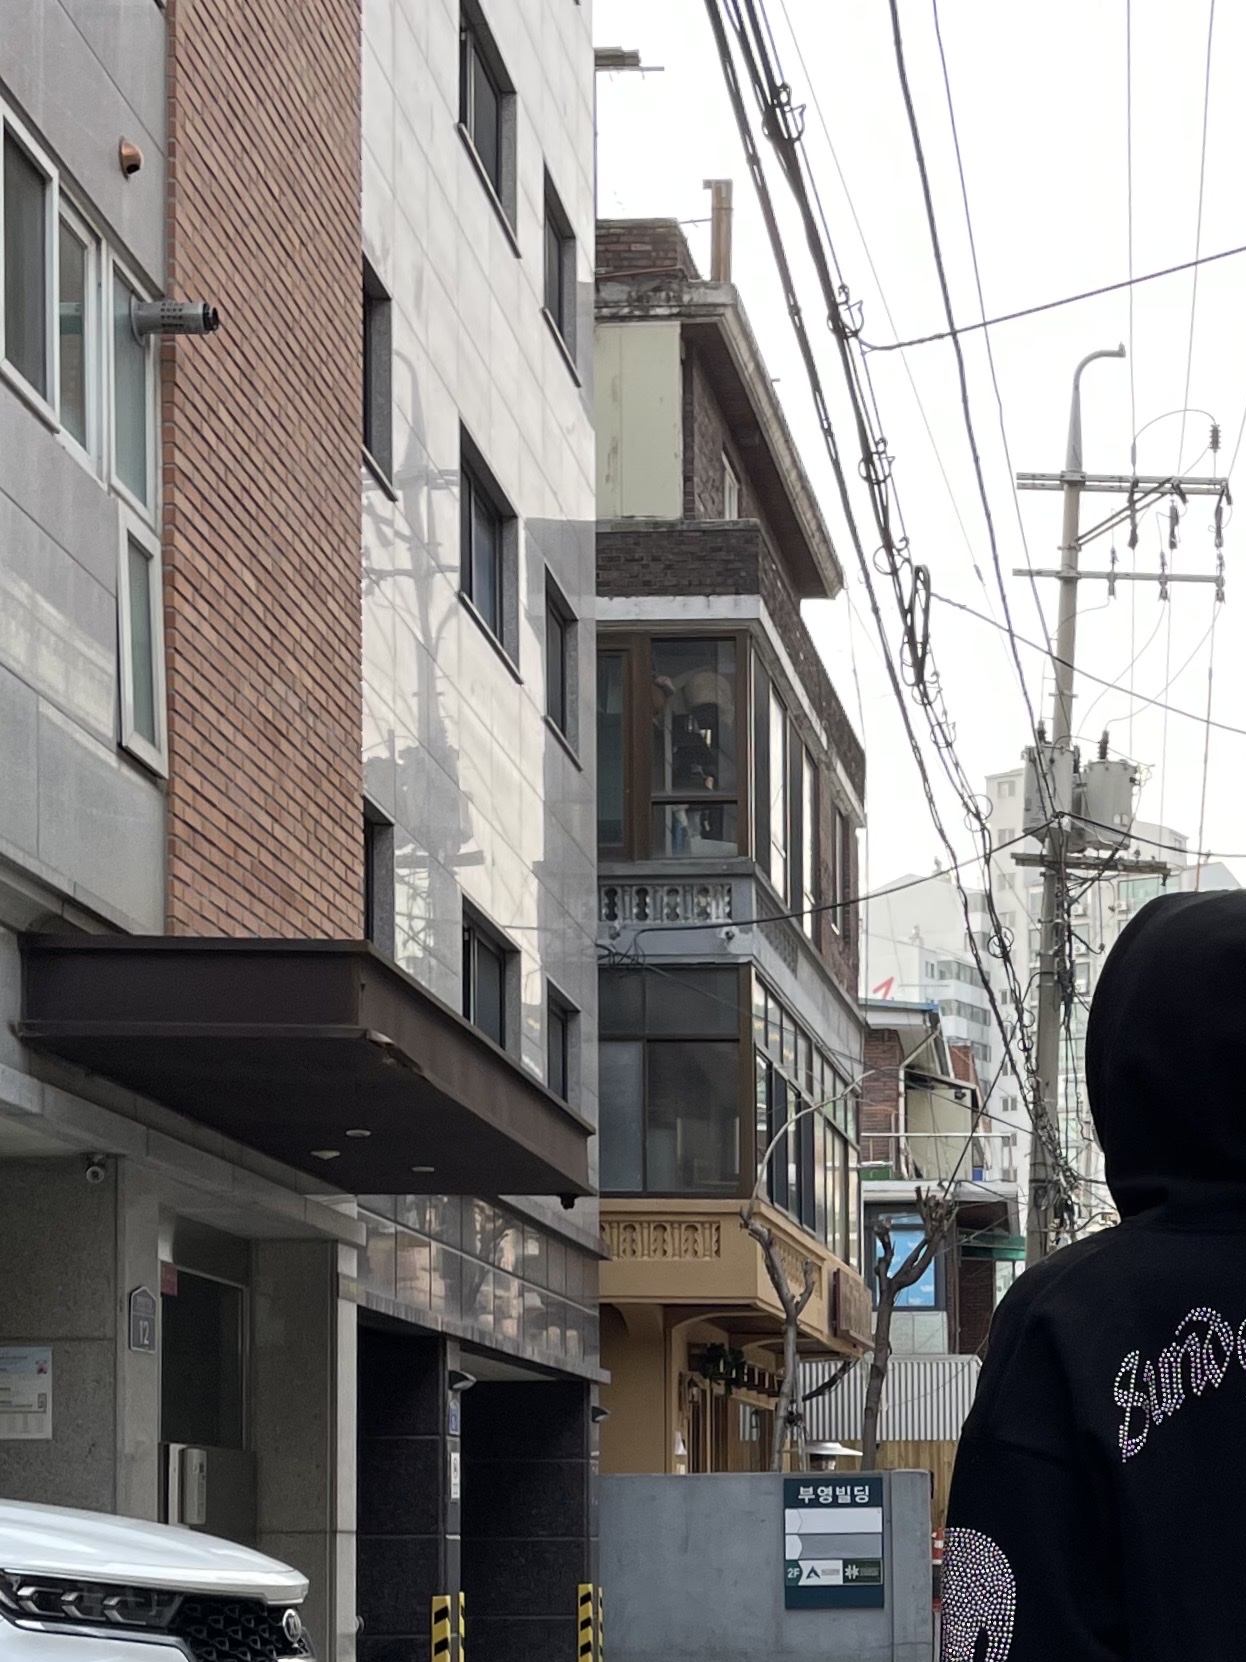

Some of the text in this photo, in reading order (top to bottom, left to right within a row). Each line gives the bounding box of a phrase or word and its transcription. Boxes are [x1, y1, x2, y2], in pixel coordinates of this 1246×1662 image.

[139, 1320, 150, 1345] 12
[797, 1485, 870, 1504] 부영빌딩
[787, 1567, 800, 1579] 2F
